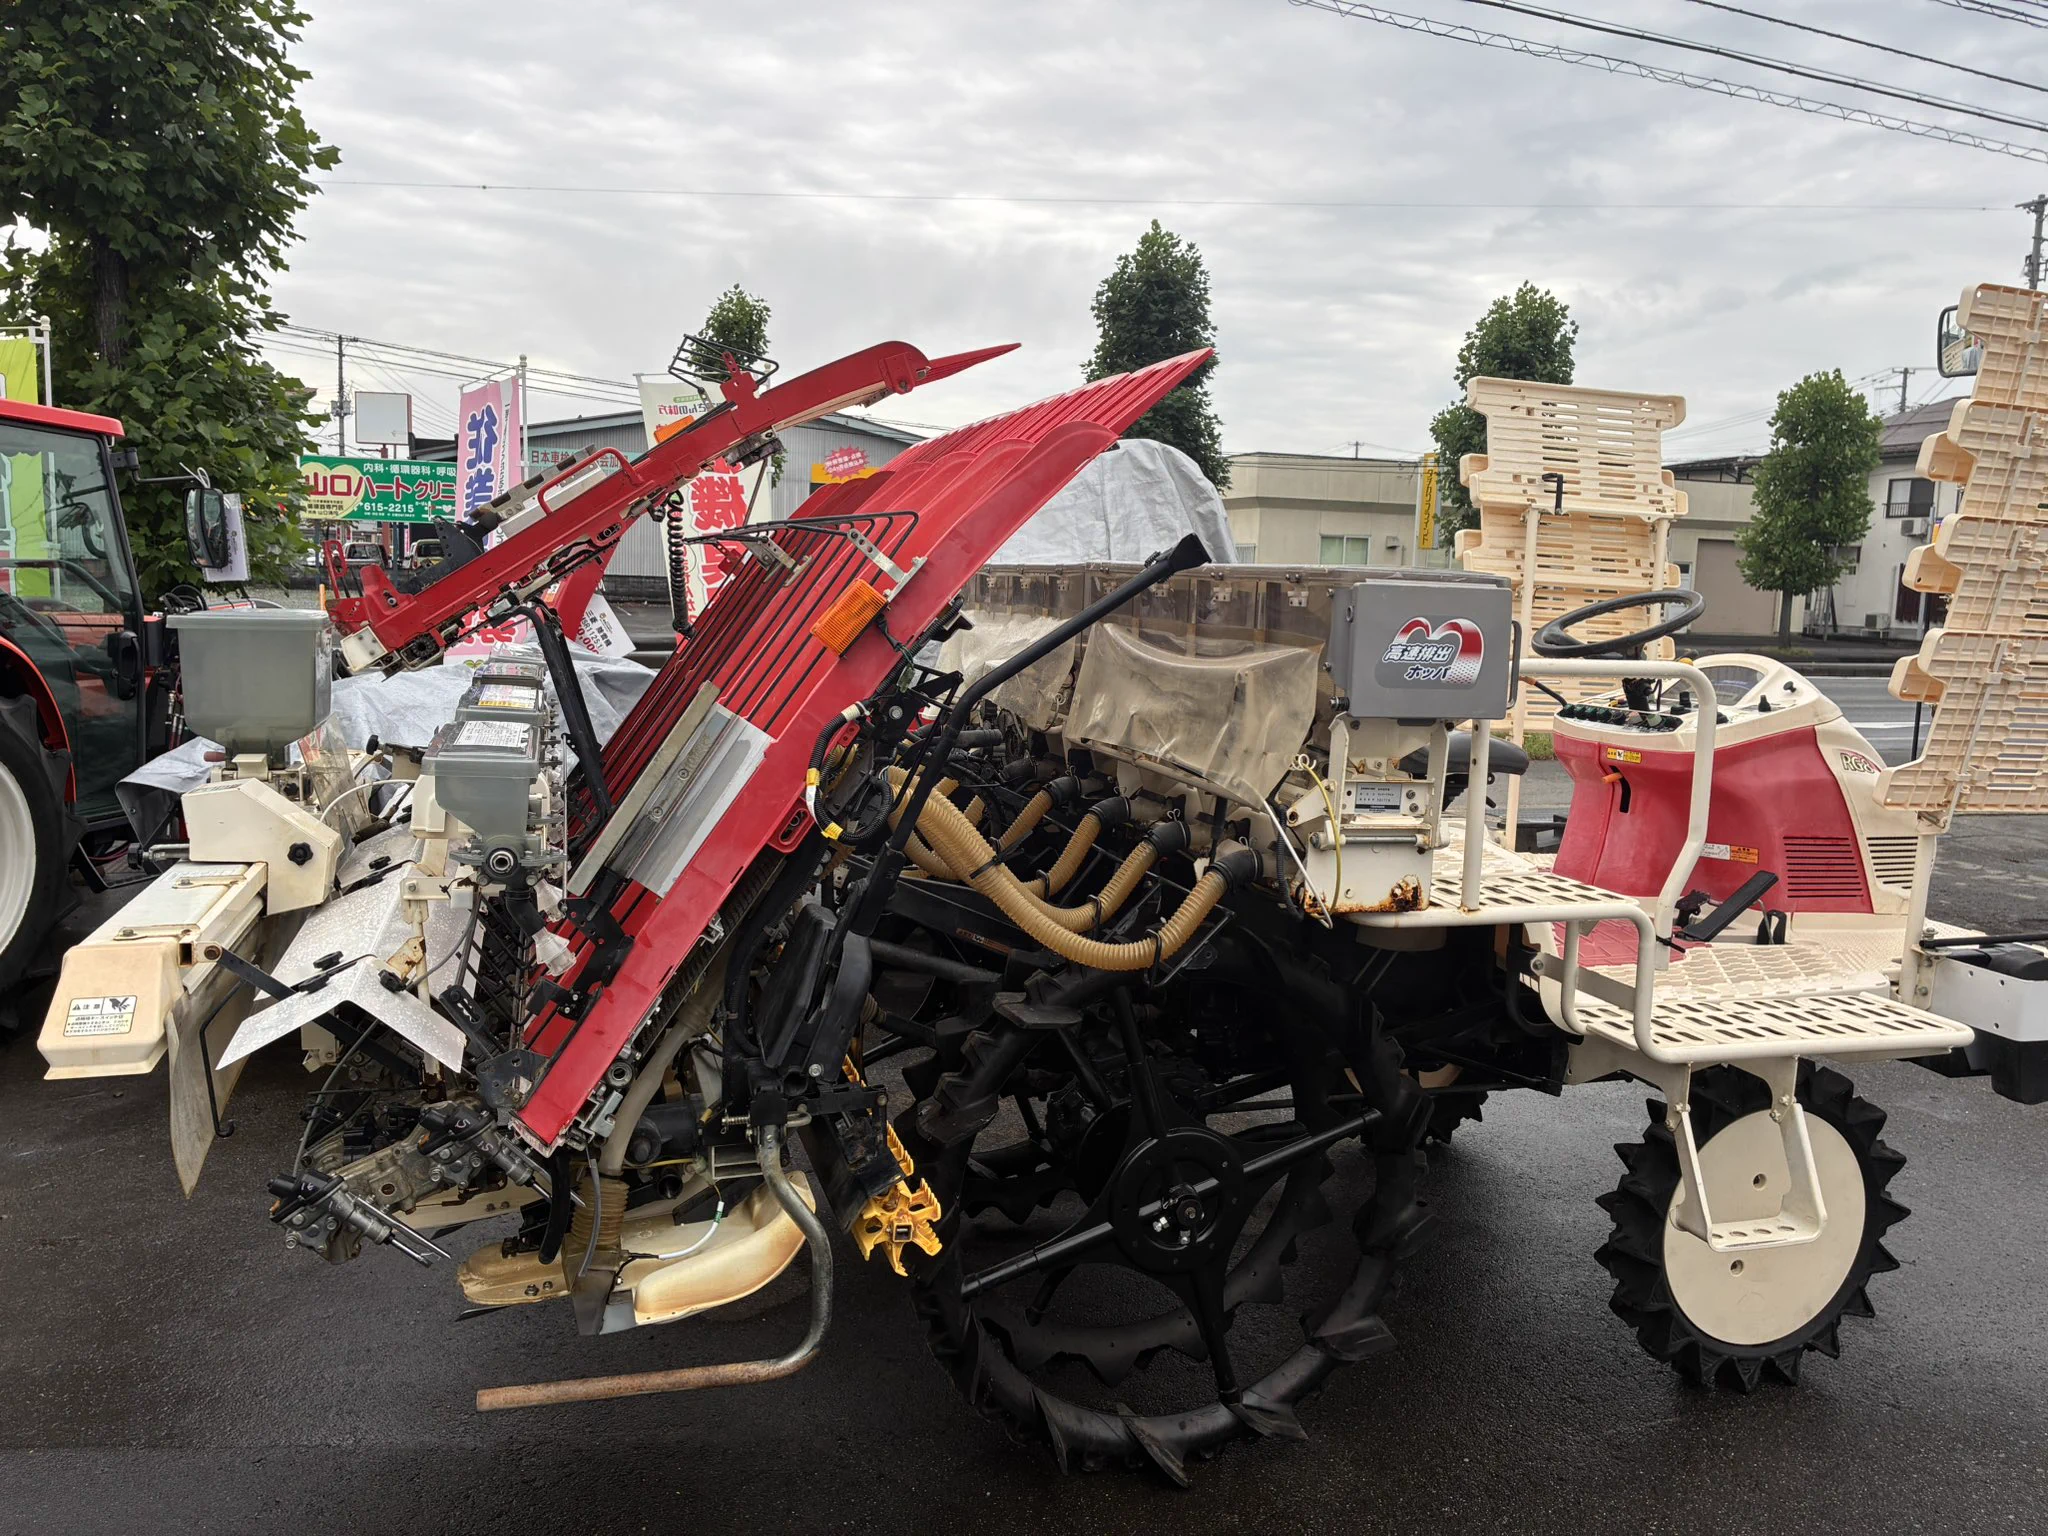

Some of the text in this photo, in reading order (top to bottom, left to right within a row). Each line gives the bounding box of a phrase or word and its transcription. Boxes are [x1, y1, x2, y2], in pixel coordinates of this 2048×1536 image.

[305, 472, 457, 499] 山口ハートクリニ
[364, 502, 414, 513] 615-2215
[1383, 643, 1455, 663] 高速排出
